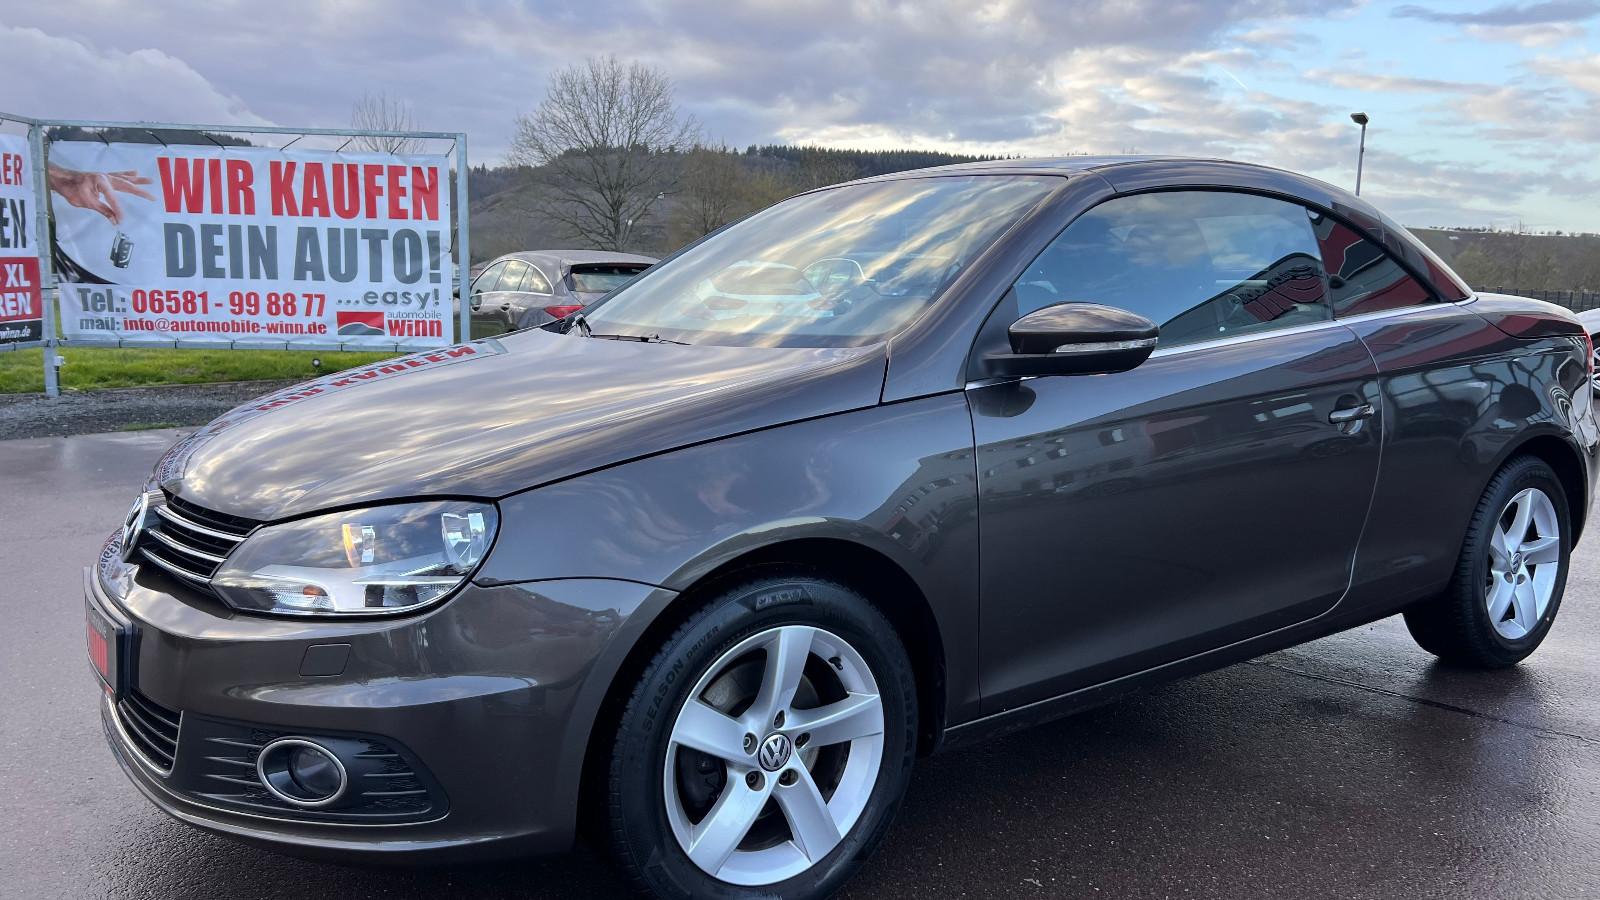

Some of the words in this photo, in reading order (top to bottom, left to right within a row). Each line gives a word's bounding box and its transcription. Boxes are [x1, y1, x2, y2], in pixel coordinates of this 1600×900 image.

[0, 153, 23, 186] ER
[157, 157, 256, 216] WIR
[269, 160, 439, 221] KAUFEN
[163, 222, 279, 280] DEIN
[293, 226, 441, 285] AUTO!
[4, 263, 31, 288] XL
[77, 287, 127, 313] Tel.:
[131, 289, 209, 315] 06581
[229, 291, 260, 316] 99
[266, 292, 297, 317] 88
[302, 293, 326, 317] 77
[387, 311, 442, 319] automobile
[79, 317, 120, 331] mail:
[123, 317, 328, 335] info@automobile-winn.de
[641, 657, 685, 732] SEASON
[686, 625, 721, 658] DRIVER
